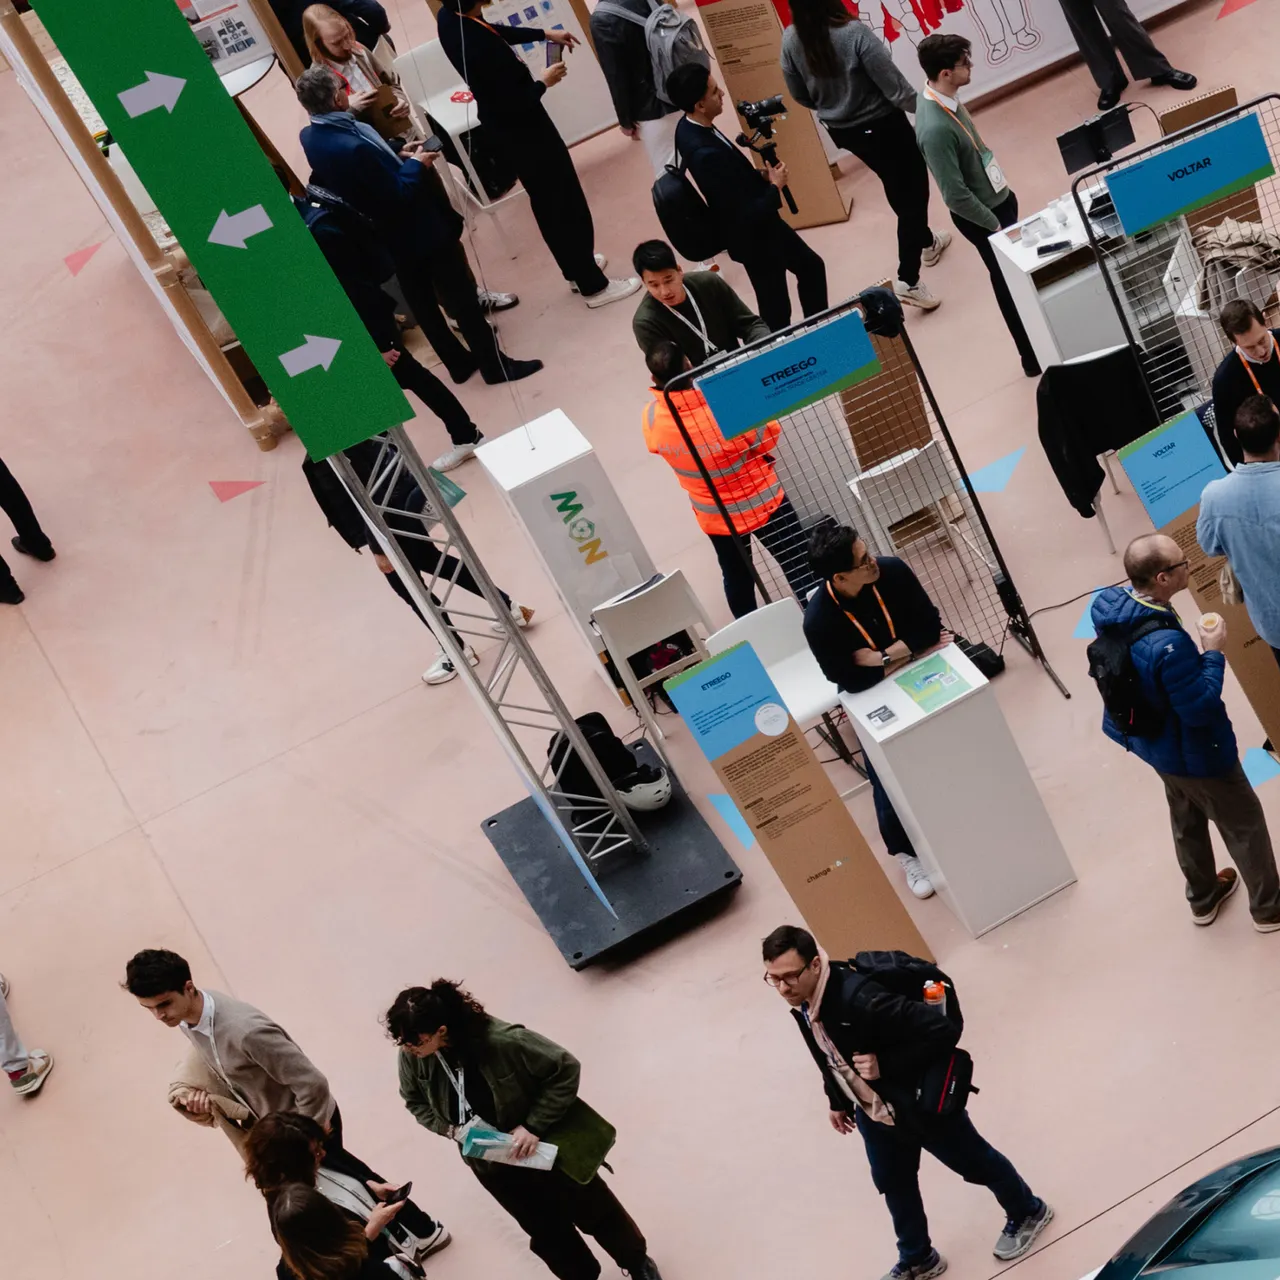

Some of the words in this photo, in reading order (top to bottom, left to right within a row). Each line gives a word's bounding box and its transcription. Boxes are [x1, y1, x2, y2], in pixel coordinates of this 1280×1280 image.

[1168, 157, 1212, 182] VOLTAR
[761, 356, 817, 387] ETREEGO
[1152, 442, 1176, 458] VOLTAR
[701, 671, 731, 691] ETREEGO
